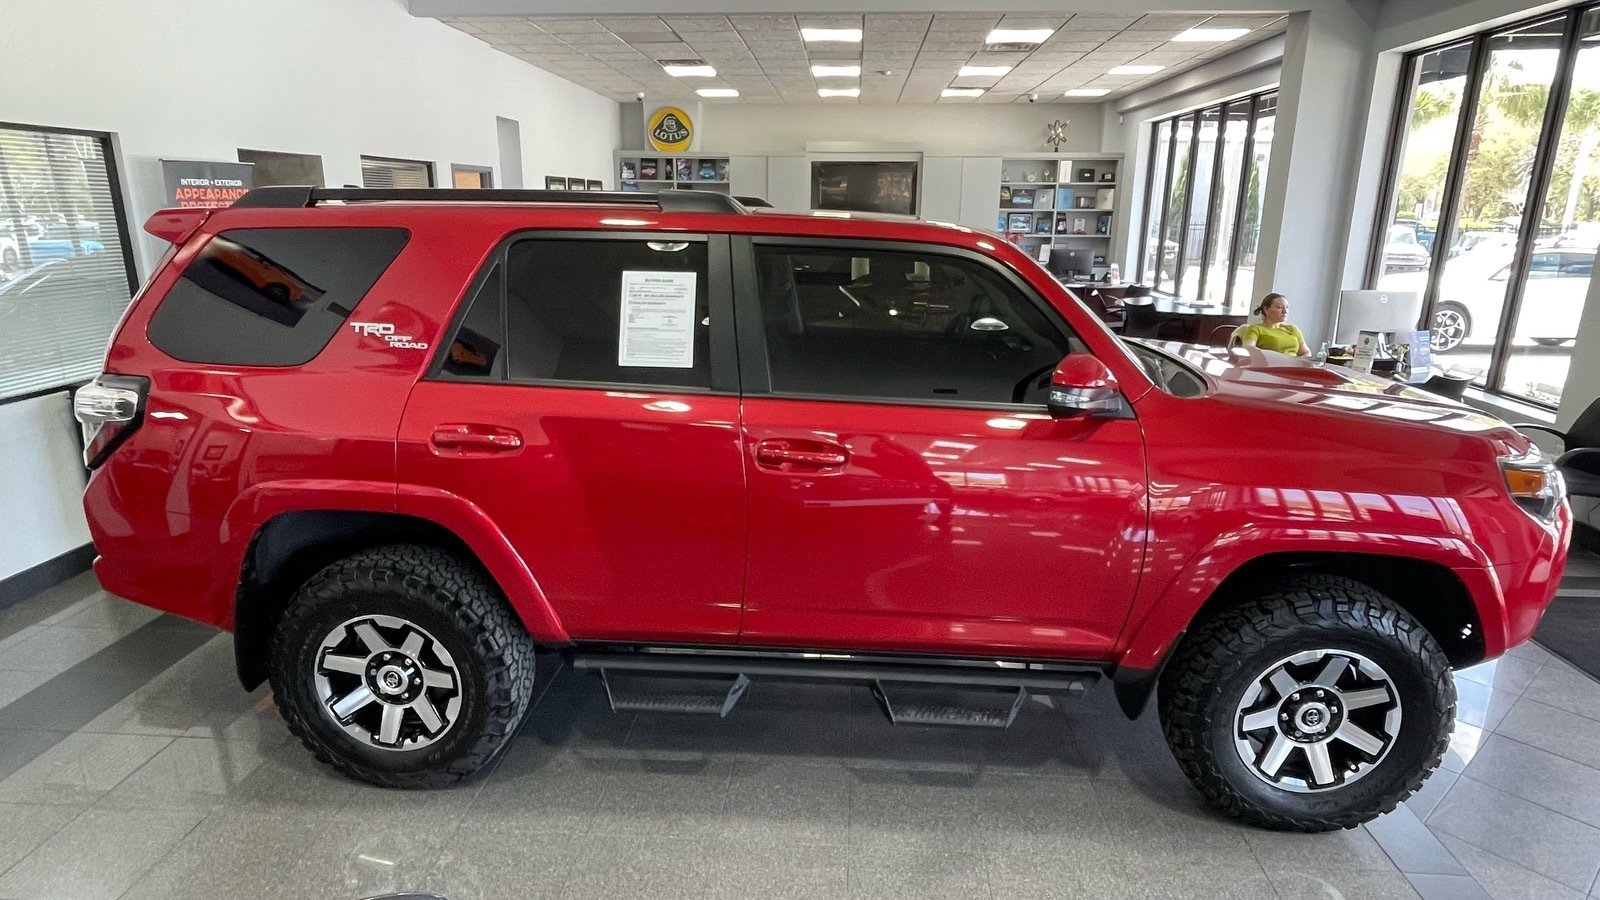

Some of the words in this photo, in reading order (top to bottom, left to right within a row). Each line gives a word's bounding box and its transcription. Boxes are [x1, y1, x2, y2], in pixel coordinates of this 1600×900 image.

[655, 129, 688, 141] LOTUS
[180, 178, 210, 186] INTERIOR
[214, 179, 243, 187] EXTERIOR
[349, 322, 395, 337] TRD
[389, 342, 428, 350] ROAD
